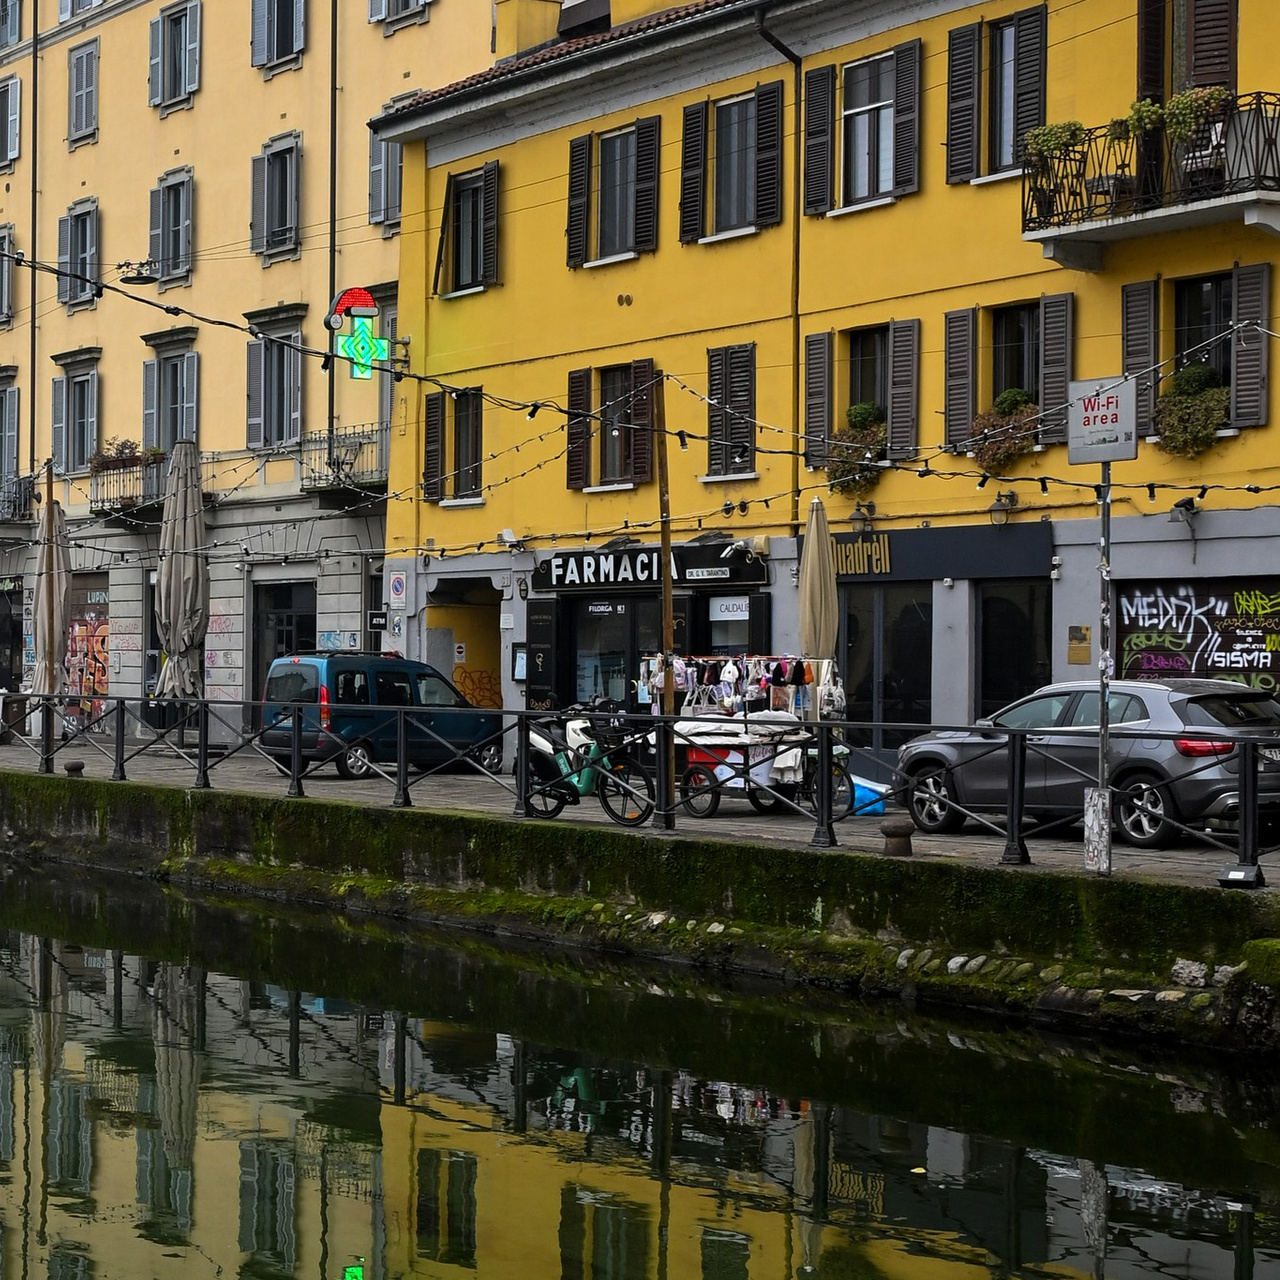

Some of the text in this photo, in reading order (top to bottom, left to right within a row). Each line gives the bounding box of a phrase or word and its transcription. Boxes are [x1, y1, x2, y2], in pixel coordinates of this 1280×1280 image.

[1083, 396, 1119, 413] Wi-Fi
[1083, 412, 1119, 427] area
[372, 617, 386, 625] ATM
[1214, 651, 1272, 669] SISMA
